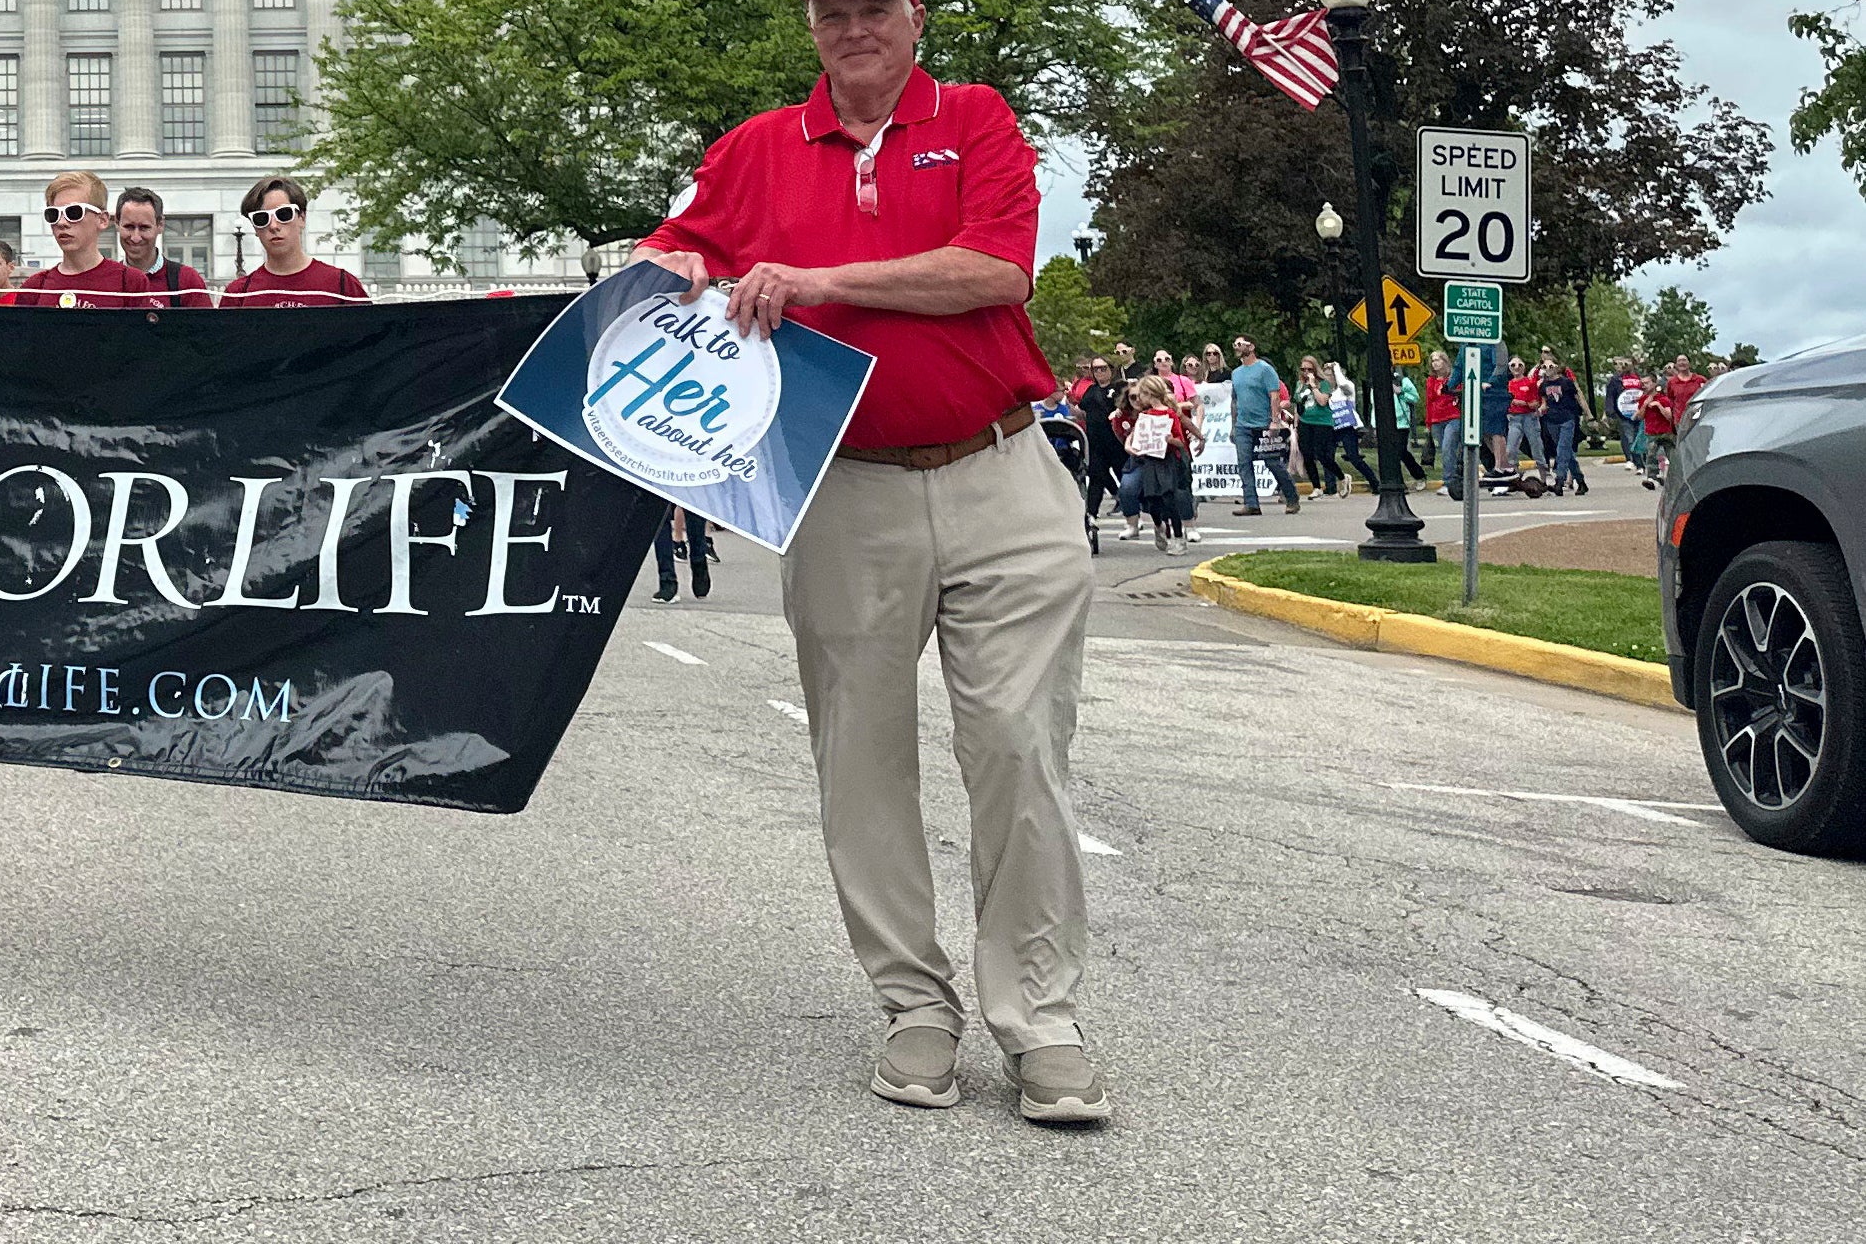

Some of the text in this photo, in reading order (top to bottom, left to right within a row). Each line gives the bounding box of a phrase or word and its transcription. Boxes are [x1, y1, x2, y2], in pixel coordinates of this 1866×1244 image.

[1432, 144, 1517, 170] SPEED
[1441, 175, 1506, 199] LIMIT
[1435, 209, 1515, 263] 20
[1456, 298, 1493, 310] CAPITOL
[1461, 287, 1488, 299] STATE
[638, 295, 741, 360] Talk to
[1452, 314, 1493, 327] VISITORS
[1453, 326, 1492, 338] PARKING
[1393, 348, 1416, 360] EAD
[587, 337, 731, 434] Her
[587, 410, 721, 481] vitaeresearchinstitute.org
[637, 414, 757, 479] about her
[200, 469, 567, 617] LIFE
